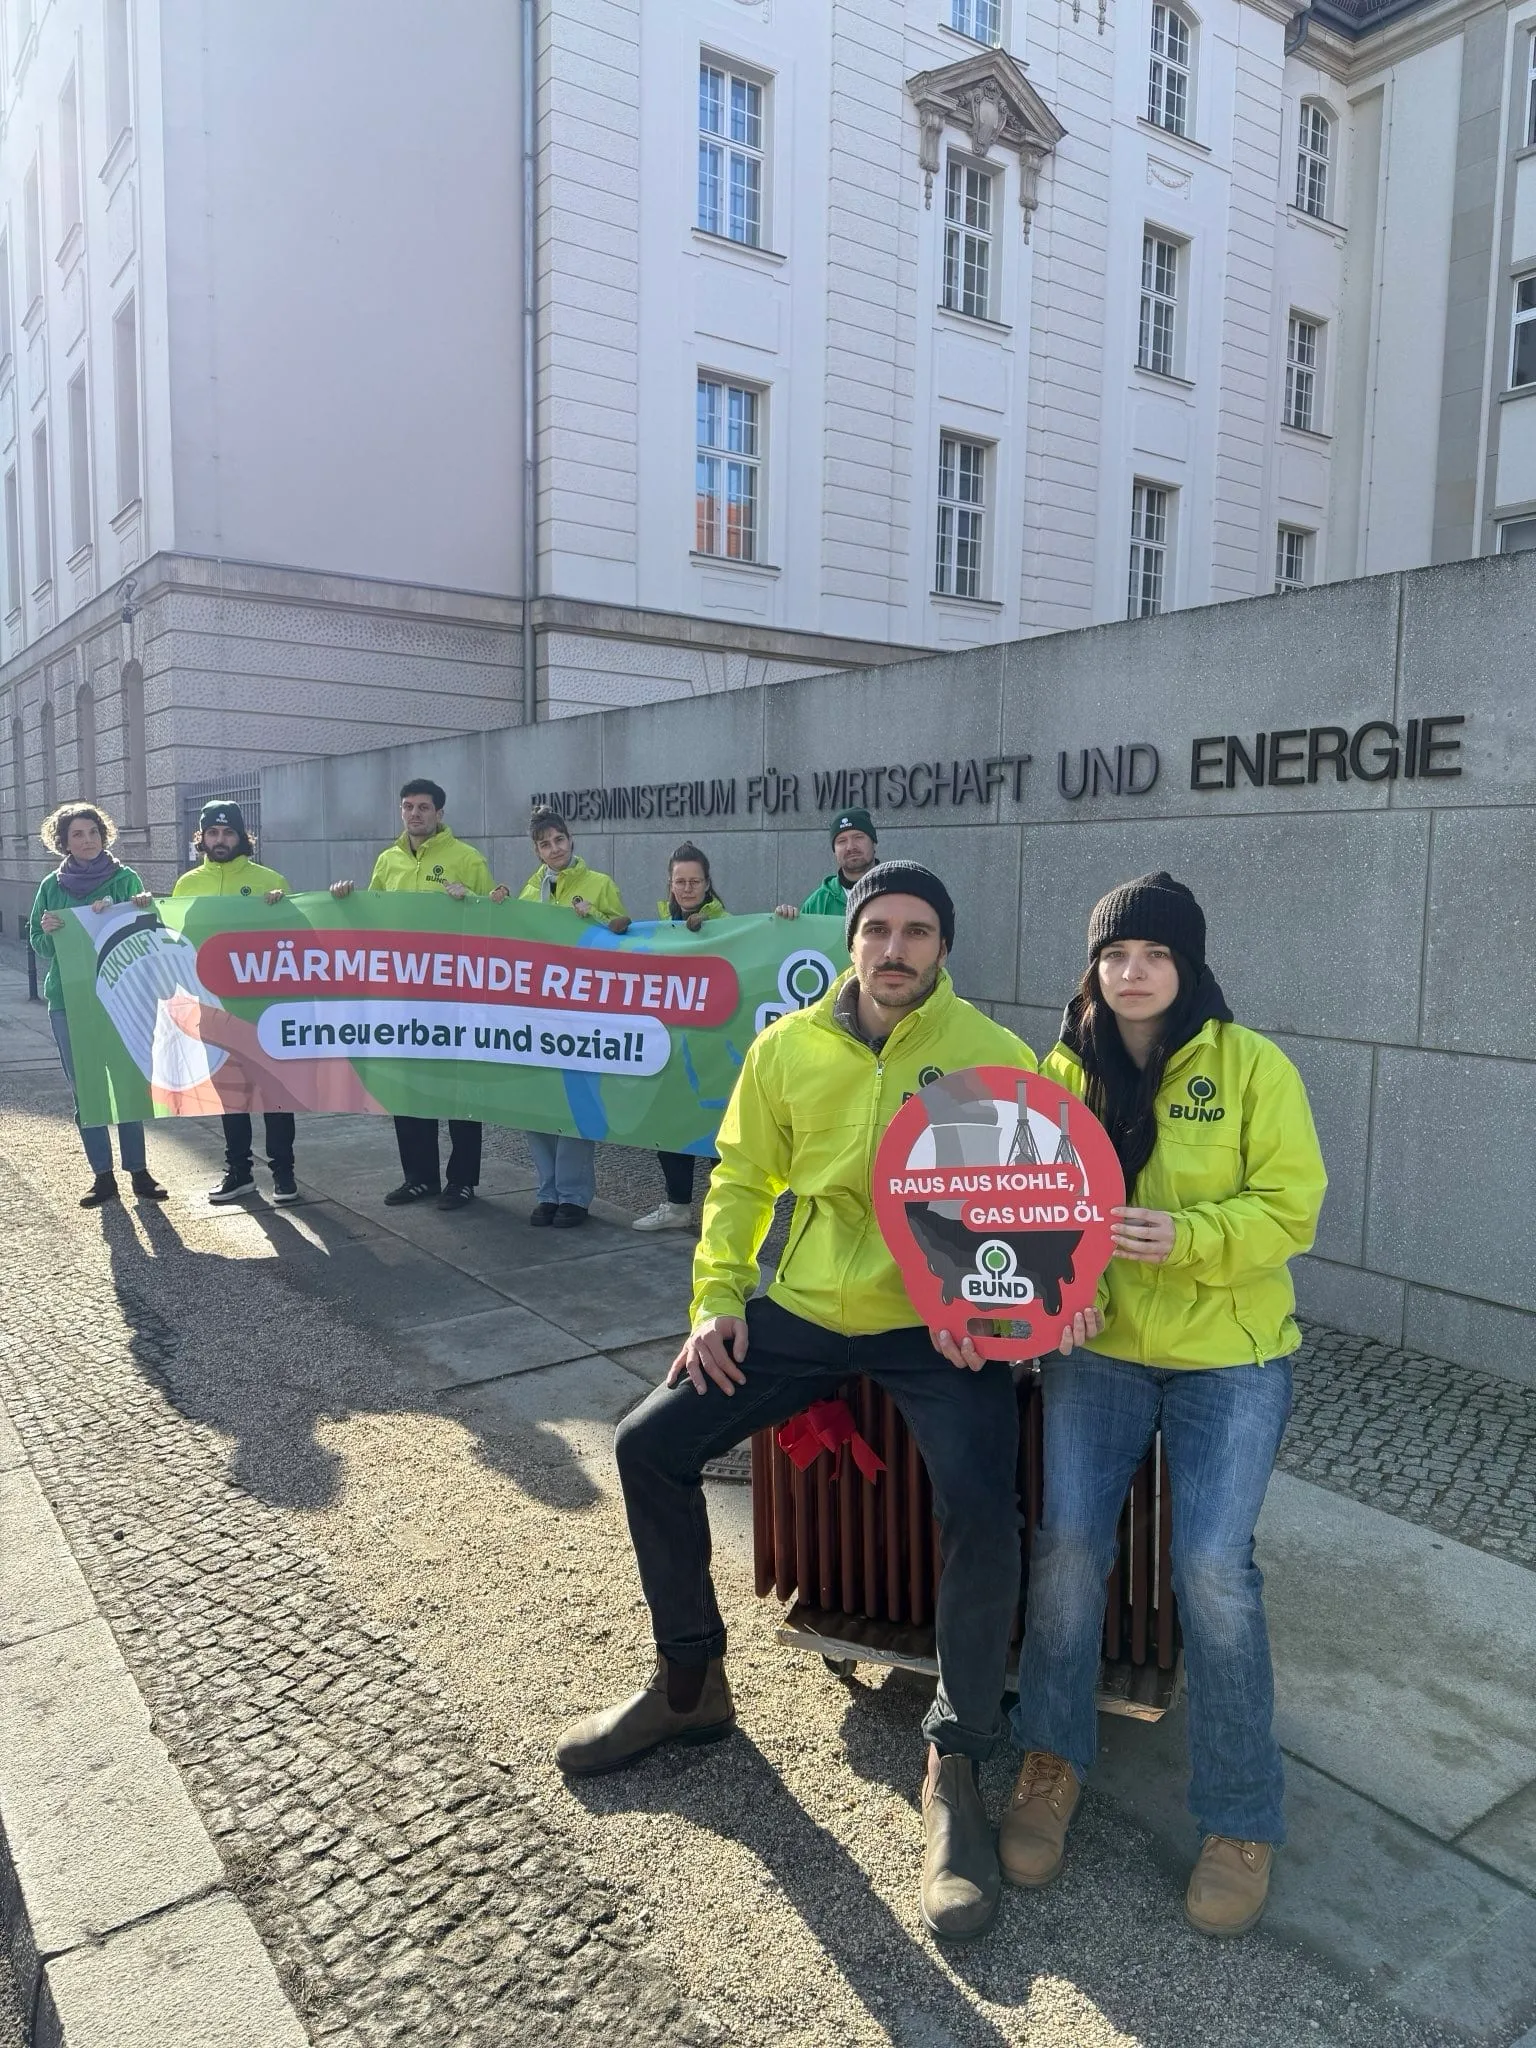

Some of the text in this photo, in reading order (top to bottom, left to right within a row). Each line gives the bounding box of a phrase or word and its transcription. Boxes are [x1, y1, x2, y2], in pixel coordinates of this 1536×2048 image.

[746, 767, 800, 815] FÜR
[813, 754, 1032, 811] WIRTSCHAFT
[1057, 742, 1160, 800] UND
[1190, 715, 1465, 790] ENERGIE
[100, 930, 160, 990] ZUKUNFT
[228, 940, 710, 1012] WÄRMEWENDE RETTEN!
[281, 1018, 644, 1062] Erneuerbar und sozial!
[1169, 1103, 1225, 1122] BUND
[889, 1172, 1075, 1195] RAUS AUS KOHLE,
[969, 1201, 1105, 1225] GAS UND ÖL
[968, 1280, 1028, 1298] BUND
